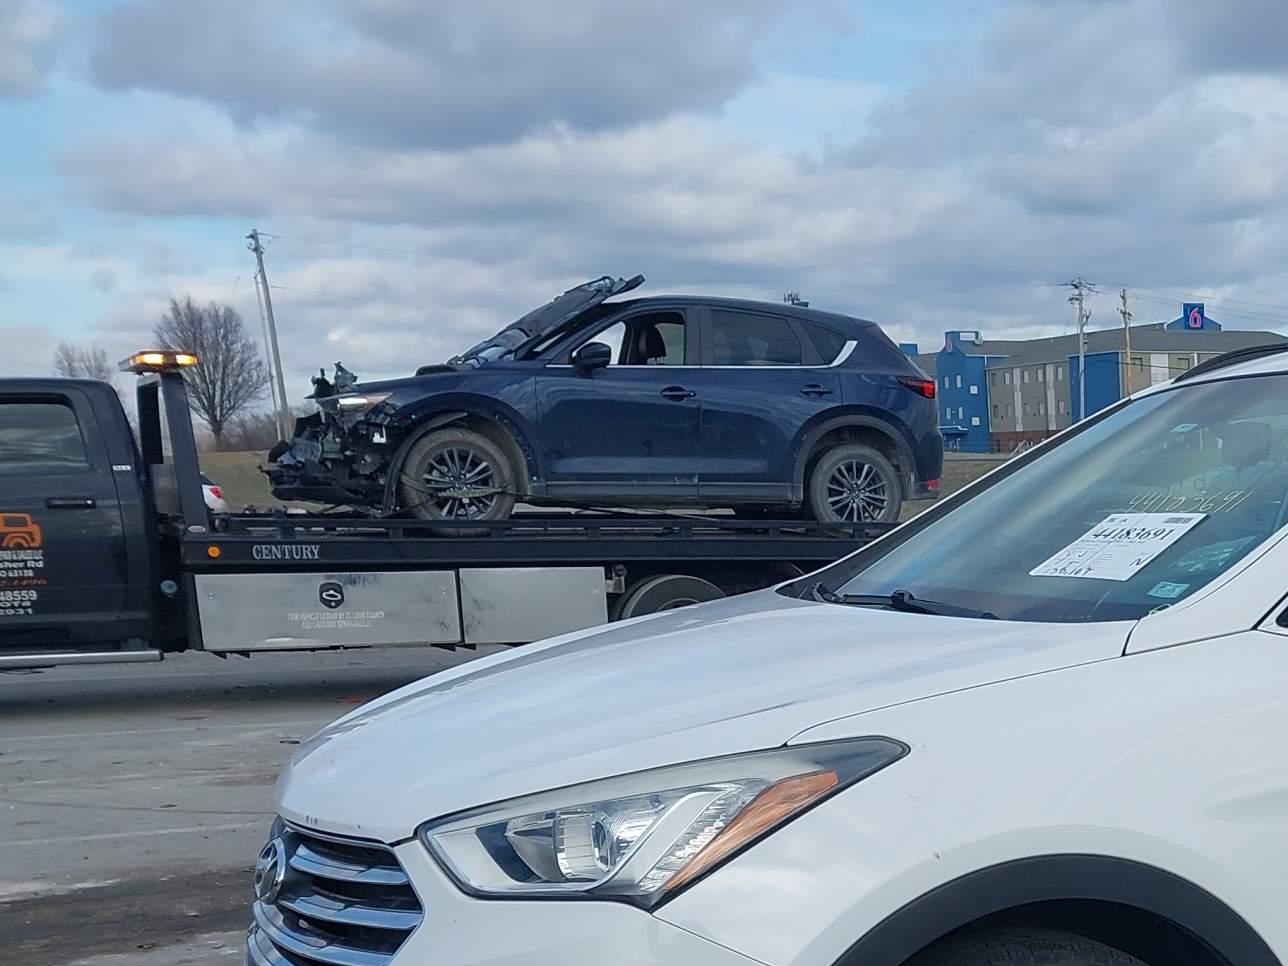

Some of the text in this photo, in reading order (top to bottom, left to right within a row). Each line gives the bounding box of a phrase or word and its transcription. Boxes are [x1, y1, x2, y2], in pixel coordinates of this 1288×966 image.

[1189, 307, 1201, 328] 6
[1092, 527, 1176, 541] 44183691
[252, 544, 320, 560] CENTURY
[27, 560, 44, 568] Rd
